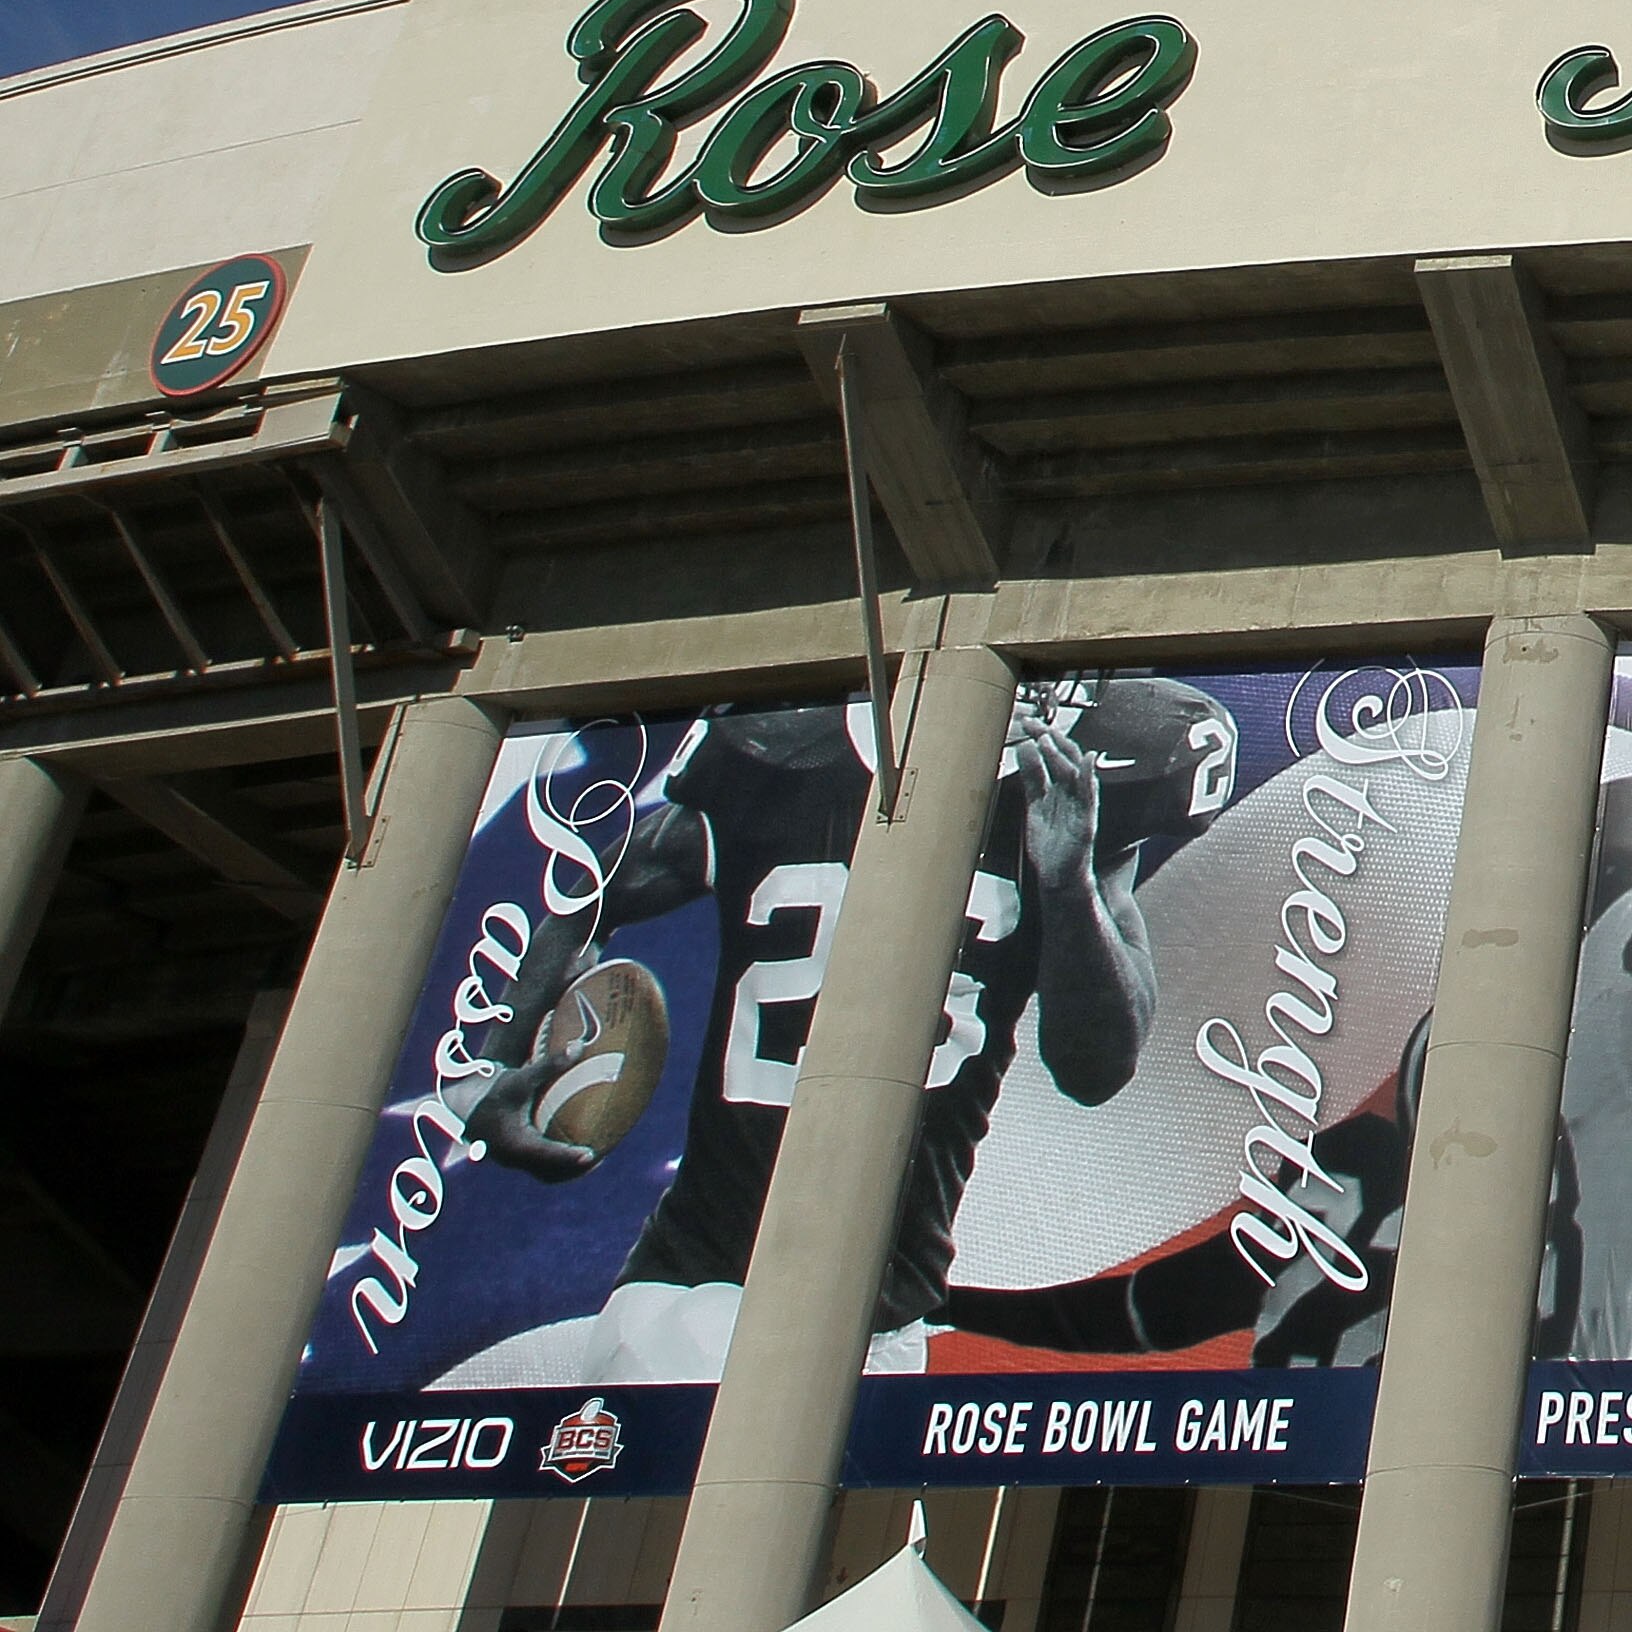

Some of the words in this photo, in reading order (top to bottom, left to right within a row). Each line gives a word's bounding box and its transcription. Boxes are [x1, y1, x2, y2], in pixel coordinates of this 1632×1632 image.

[160, 280, 270, 365] 25
[1196, 658, 1464, 1293] Strength
[350, 711, 649, 1355] Passion
[359, 1416, 514, 1472] VIZIO
[557, 1428, 613, 1450] BCS
[921, 1402, 1033, 1455] ROSE
[1041, 1400, 1157, 1453] BOWL
[1175, 1398, 1294, 1452] GAME
